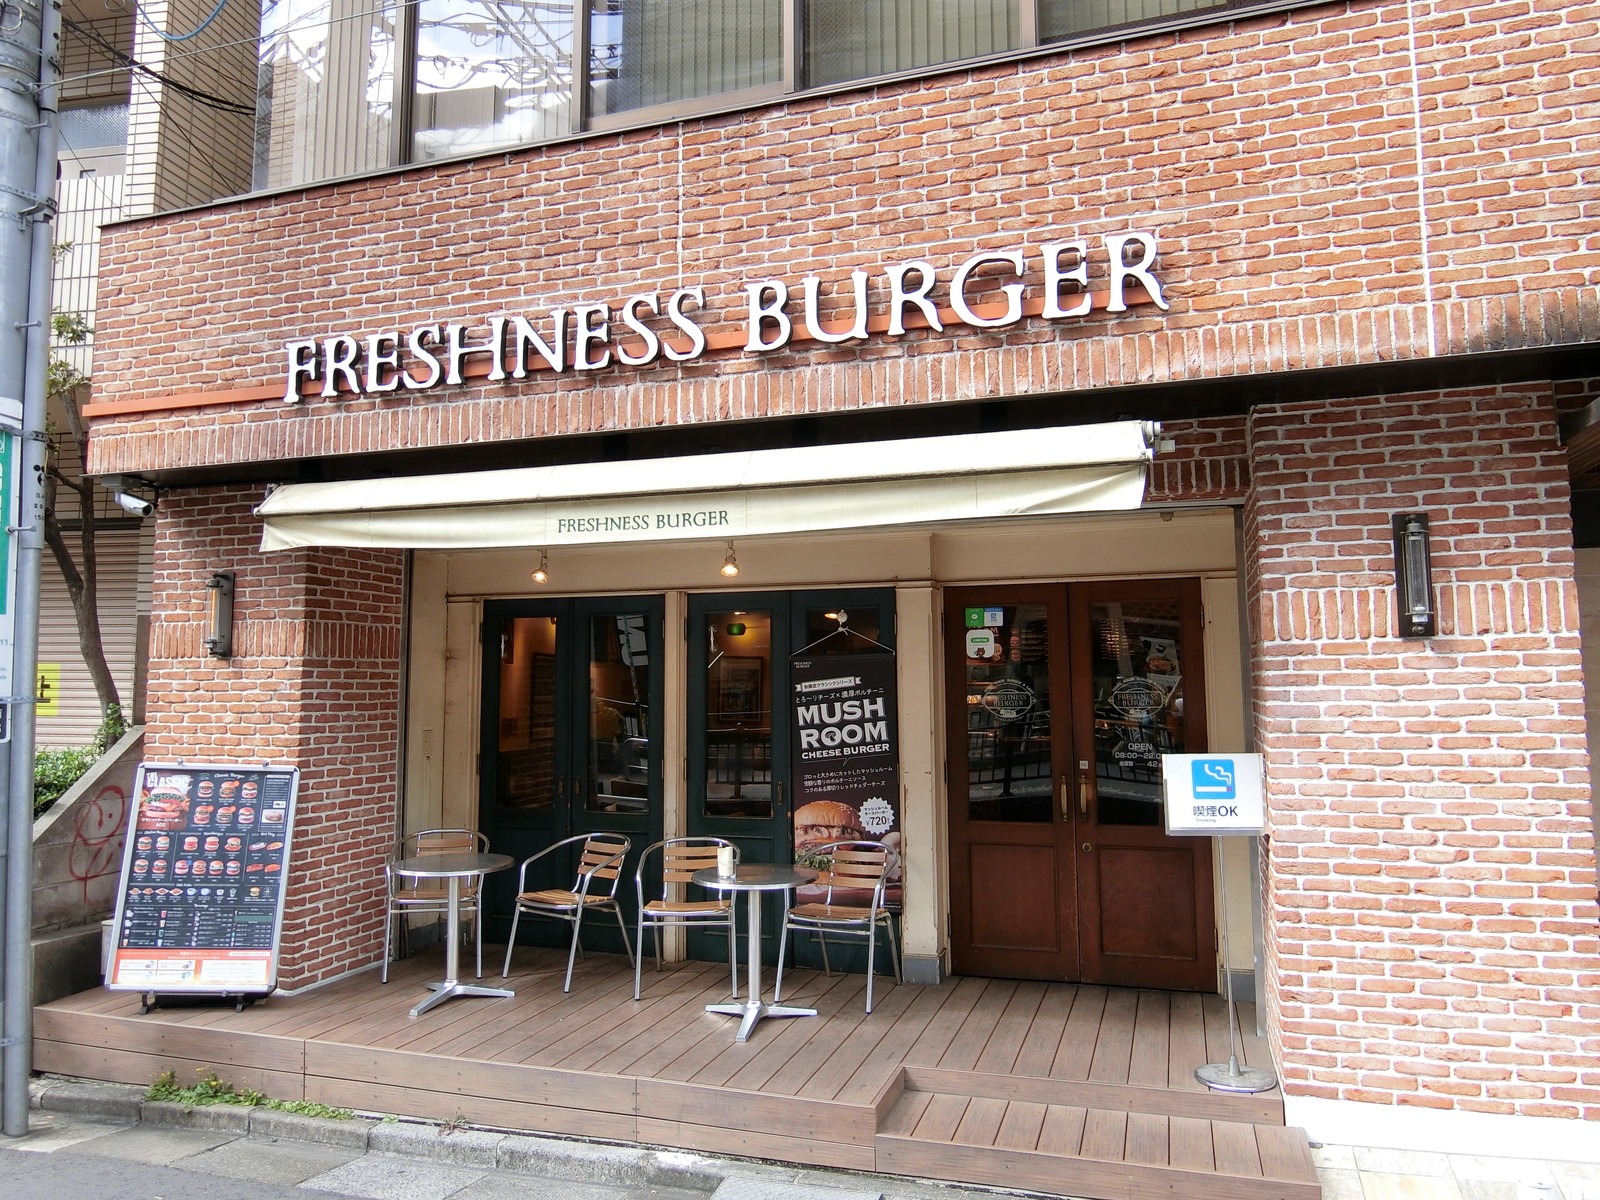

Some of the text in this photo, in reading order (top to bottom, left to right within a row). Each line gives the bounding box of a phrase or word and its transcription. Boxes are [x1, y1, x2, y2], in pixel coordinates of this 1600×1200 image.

[283, 231, 1169, 404] FRESHNESS BURGER
[558, 510, 729, 533] FRESHNESS BURGER
[797, 697, 886, 726] MUSH
[800, 721, 890, 750] ROOM
[802, 743, 890, 759] CHEESE BURGER
[1127, 742, 1153, 750] OPEN
[147, 774, 193, 788] CLASSIC
[1193, 805, 1239, 817] 喫煙OK
